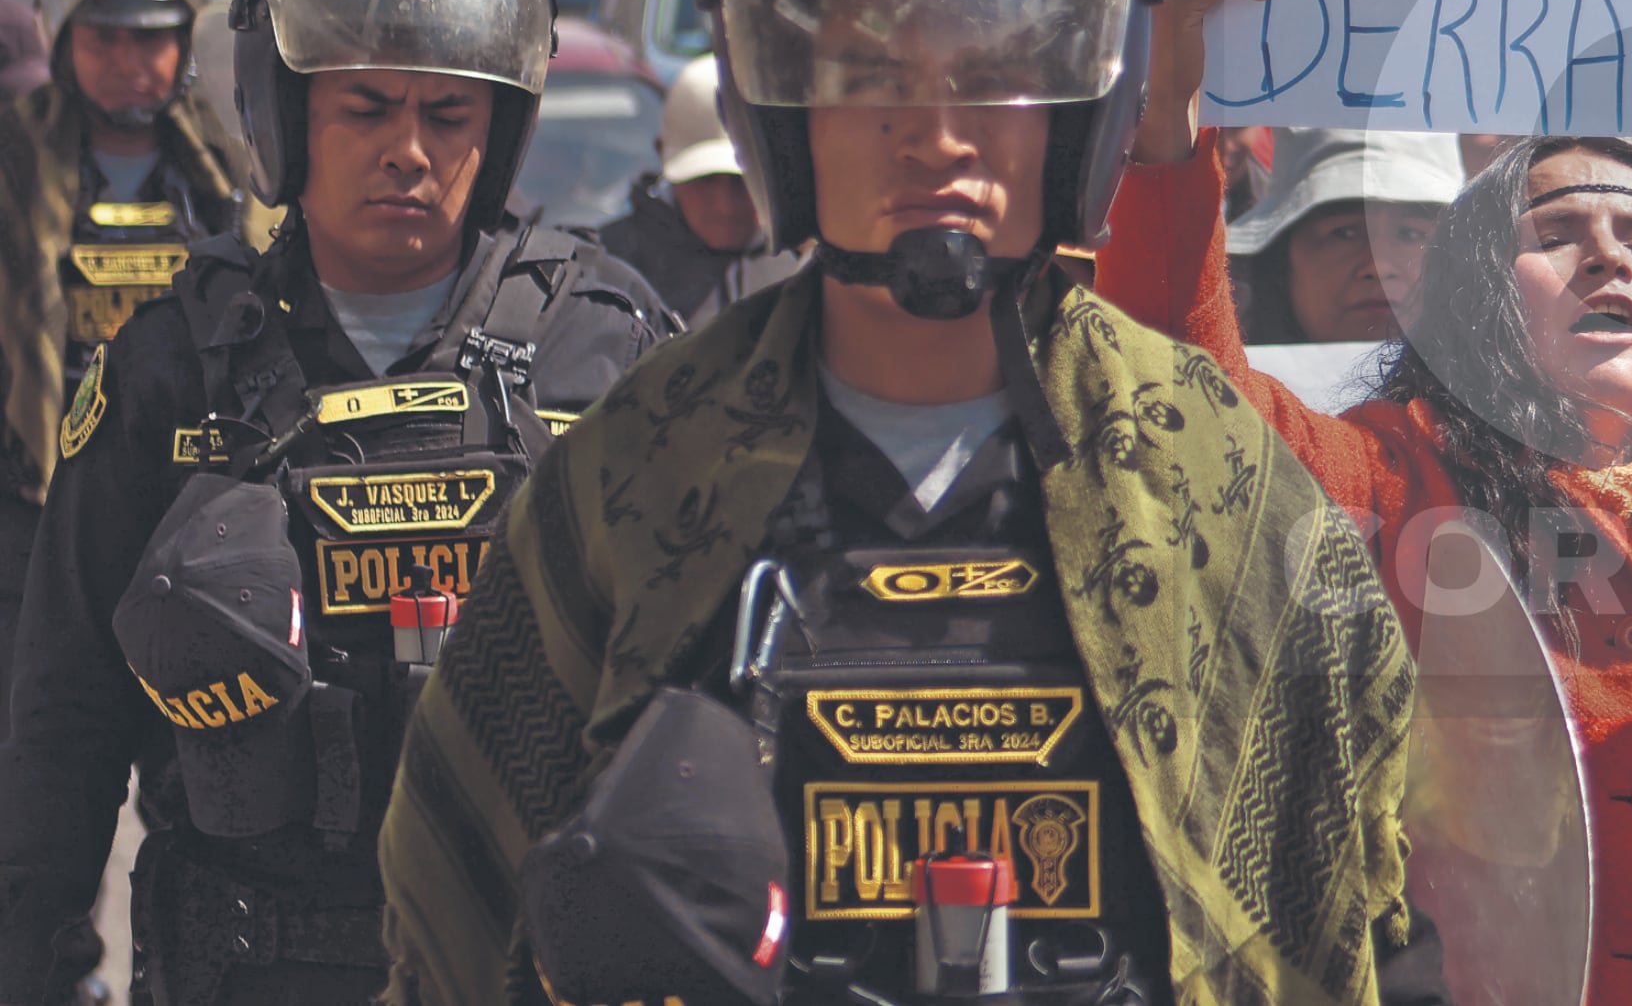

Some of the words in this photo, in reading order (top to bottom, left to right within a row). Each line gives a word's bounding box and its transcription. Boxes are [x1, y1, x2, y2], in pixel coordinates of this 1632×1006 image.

[337, 487, 354, 507] J.
[366, 482, 448, 508] VASQUEZ
[459, 481, 476, 501] L.
[351, 504, 406, 525] SUBOFICIAL
[434, 502, 460, 520] 2024
[835, 704, 862, 728] C.
[875, 702, 1017, 729] PALACIOS
[1029, 703, 1055, 727] B.
[849, 733, 951, 752] SUBOFICIAL
[958, 734, 993, 751] 3RA
[1001, 732, 1041, 750] 2024
